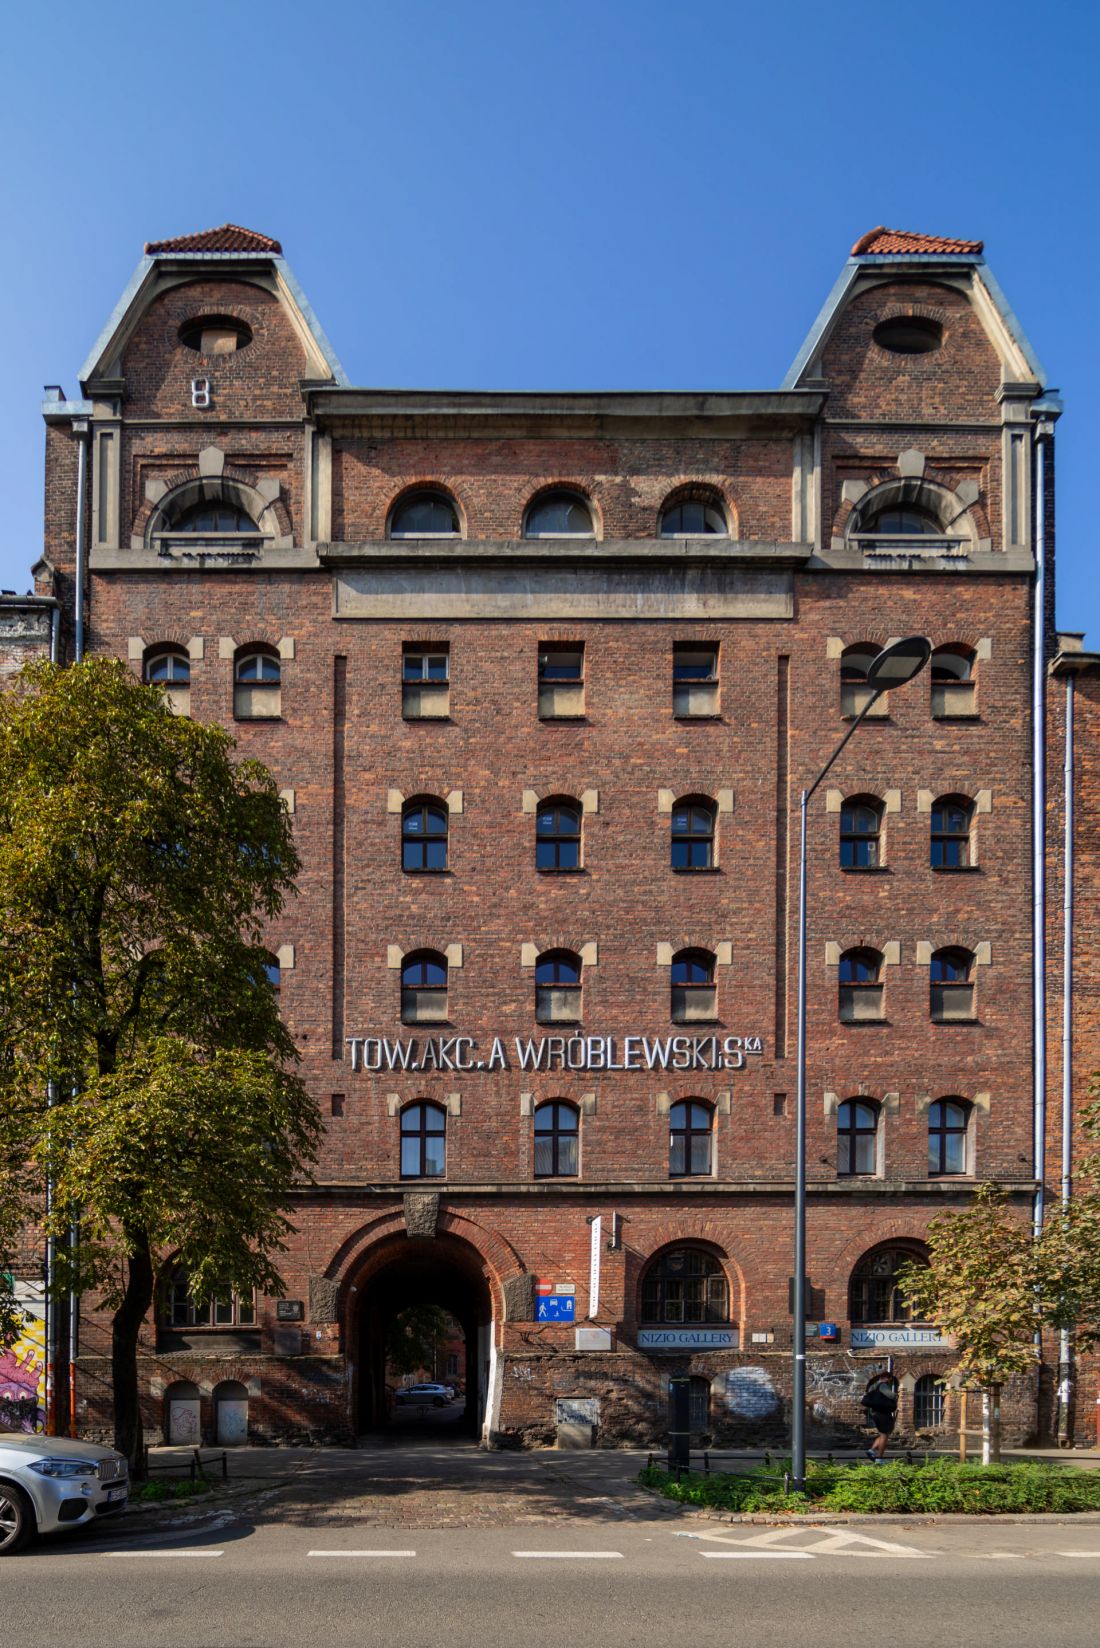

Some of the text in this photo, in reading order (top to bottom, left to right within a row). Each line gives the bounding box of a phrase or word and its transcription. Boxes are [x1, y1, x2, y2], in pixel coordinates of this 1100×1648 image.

[514, 1030, 717, 1070] WRÓBLEWSKI
[825, 1326, 832, 1337] 3
[641, 1333, 734, 1343] NIZIO GALLERY
[851, 1332, 886, 1343] NIZIO
